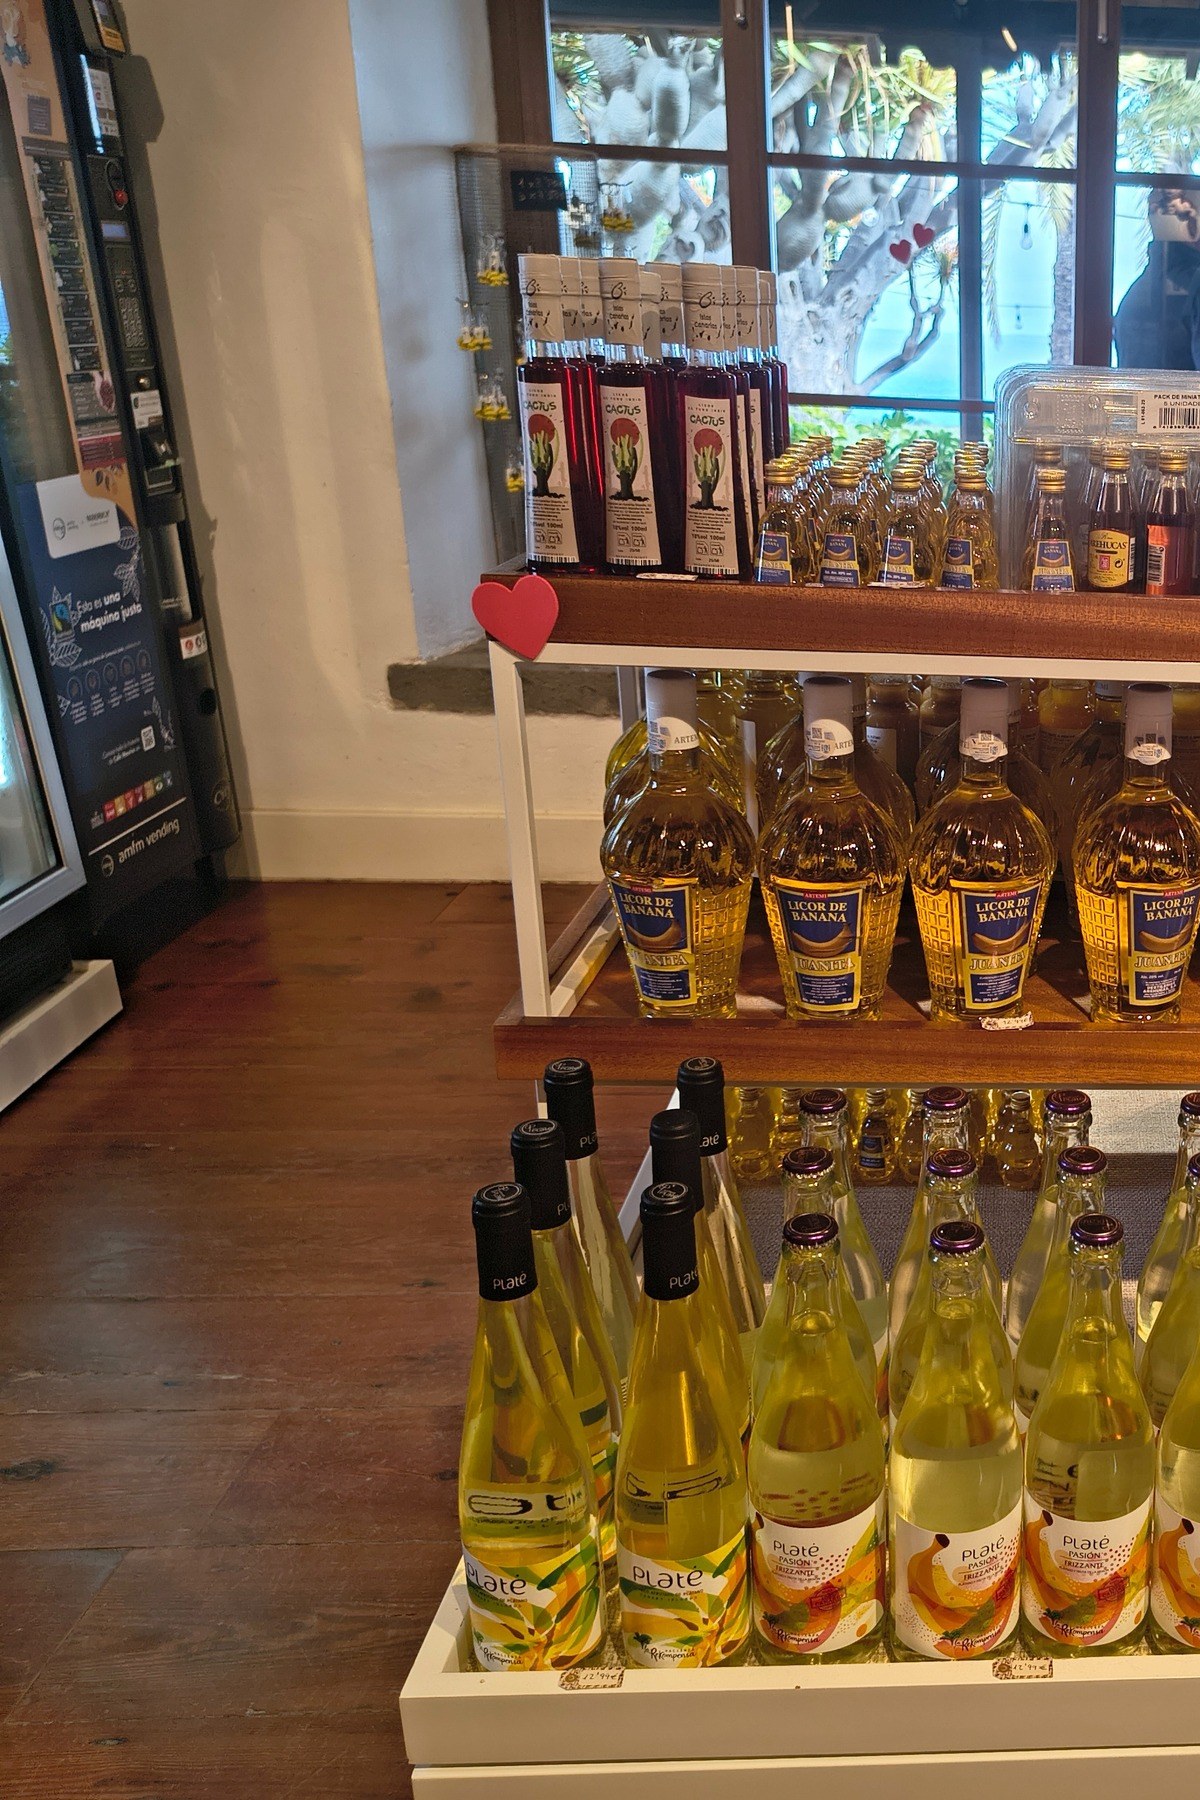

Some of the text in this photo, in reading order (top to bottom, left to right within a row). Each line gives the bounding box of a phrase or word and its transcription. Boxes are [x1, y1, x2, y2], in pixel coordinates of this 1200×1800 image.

[605, 404, 641, 416] CACTUS
[690, 414, 725, 427] CACTUS
[103, 592, 121, 606] una
[80, 602, 142, 633] máquina justa
[146, 816, 180, 848] vending
[618, 892, 674, 908] LICOR DE
[788, 900, 848, 912] LICOR DE
[976, 896, 1031, 913] LICOR DE
[1143, 895, 1196, 911] LICOR DE
[624, 903, 675, 919] BANANA
[792, 911, 847, 922] BANANA
[978, 907, 1028, 923] BANANA
[1146, 906, 1193, 922] BANANA
[779, 1556, 811, 1566] PASIÓN
[968, 1554, 998, 1569] PASIÓN
[1068, 1549, 1101, 1559] PASIÓN
[776, 1565, 815, 1576] FRIZZANTE
[1064, 1560, 1104, 1570] FRIZZANTE
[963, 1565, 1000, 1581] FRIZZANTE
